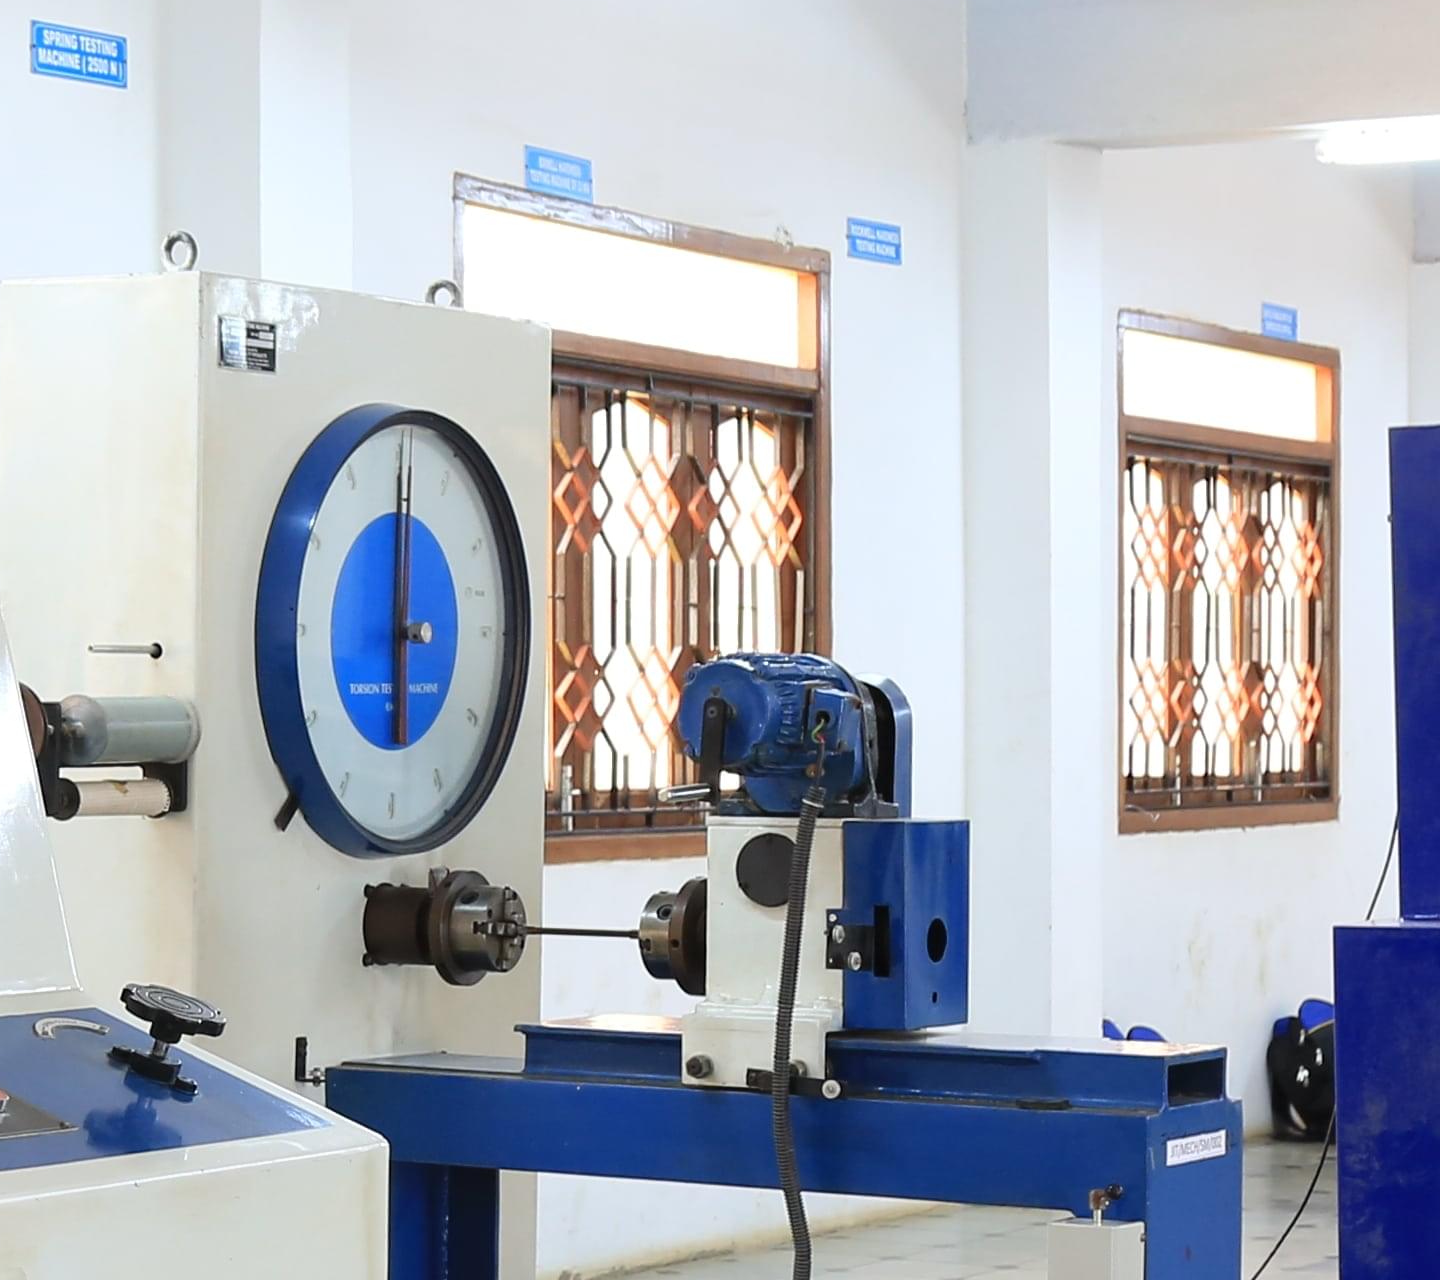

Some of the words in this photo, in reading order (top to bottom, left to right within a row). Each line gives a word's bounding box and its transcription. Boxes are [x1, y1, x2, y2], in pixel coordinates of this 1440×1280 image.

[43, 28, 78, 50] SPRING
[79, 35, 118, 57] TESTING
[38, 47, 81, 70] MACHINE
[349, 682, 380, 695] TORSION
[408, 683, 438, 695] MACHINE
